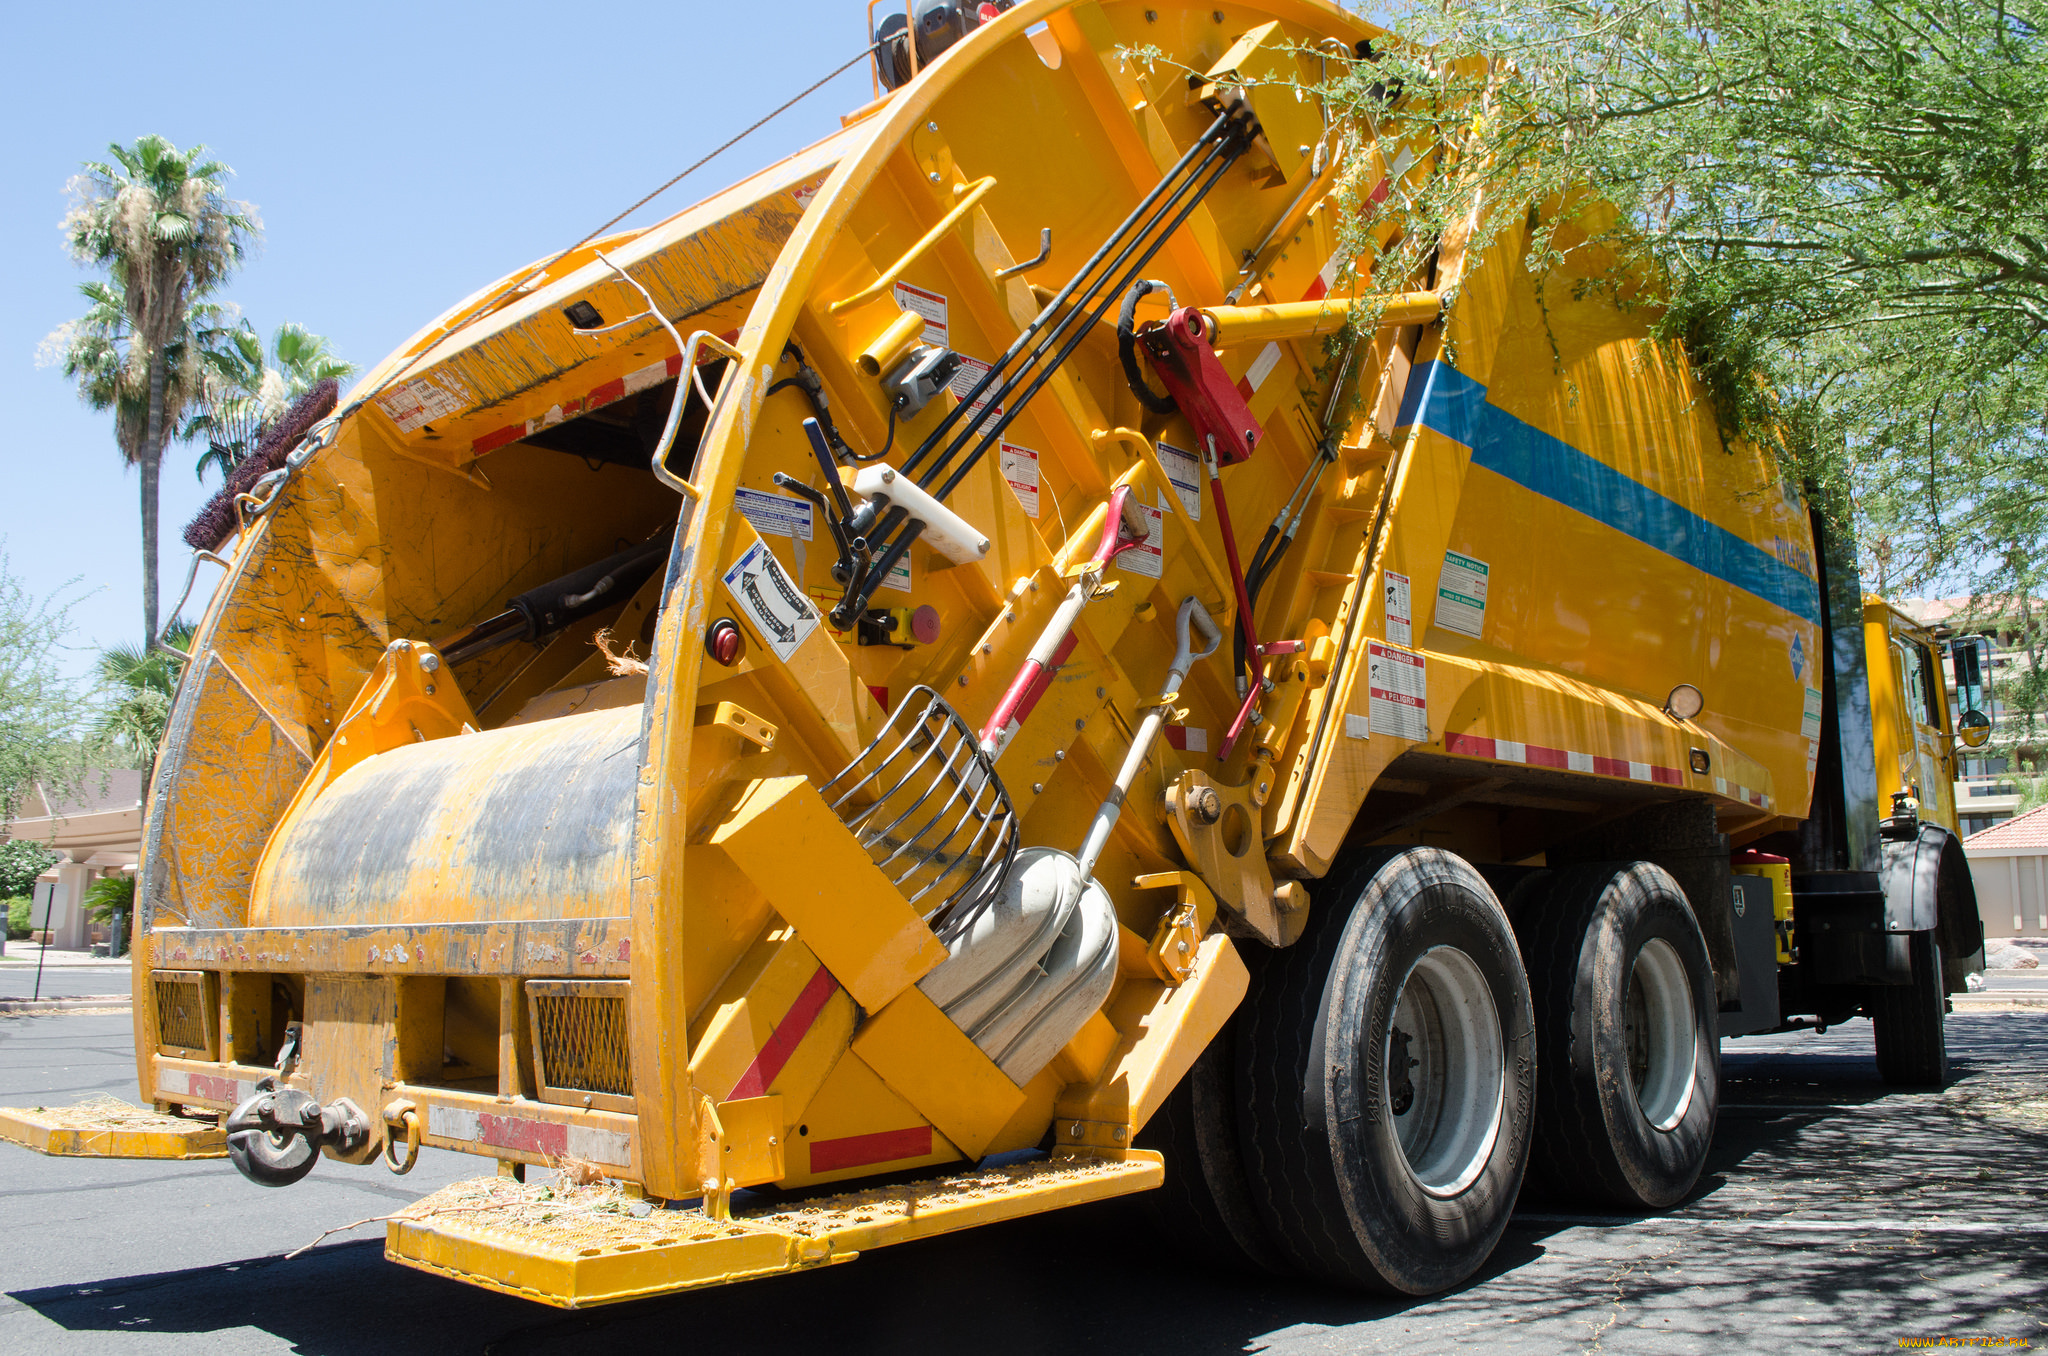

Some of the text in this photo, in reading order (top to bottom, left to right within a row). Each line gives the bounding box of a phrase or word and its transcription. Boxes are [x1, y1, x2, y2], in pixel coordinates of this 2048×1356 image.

[970, 360, 988, 370] DANGER
[1446, 554, 1484, 573] SAFETY NOTICE
[772, 575, 792, 602] SLIDE
[752, 599, 776, 630] PACKER
[1387, 650, 1414, 665] DANGER
[1388, 692, 1415, 706] PELIGRO
